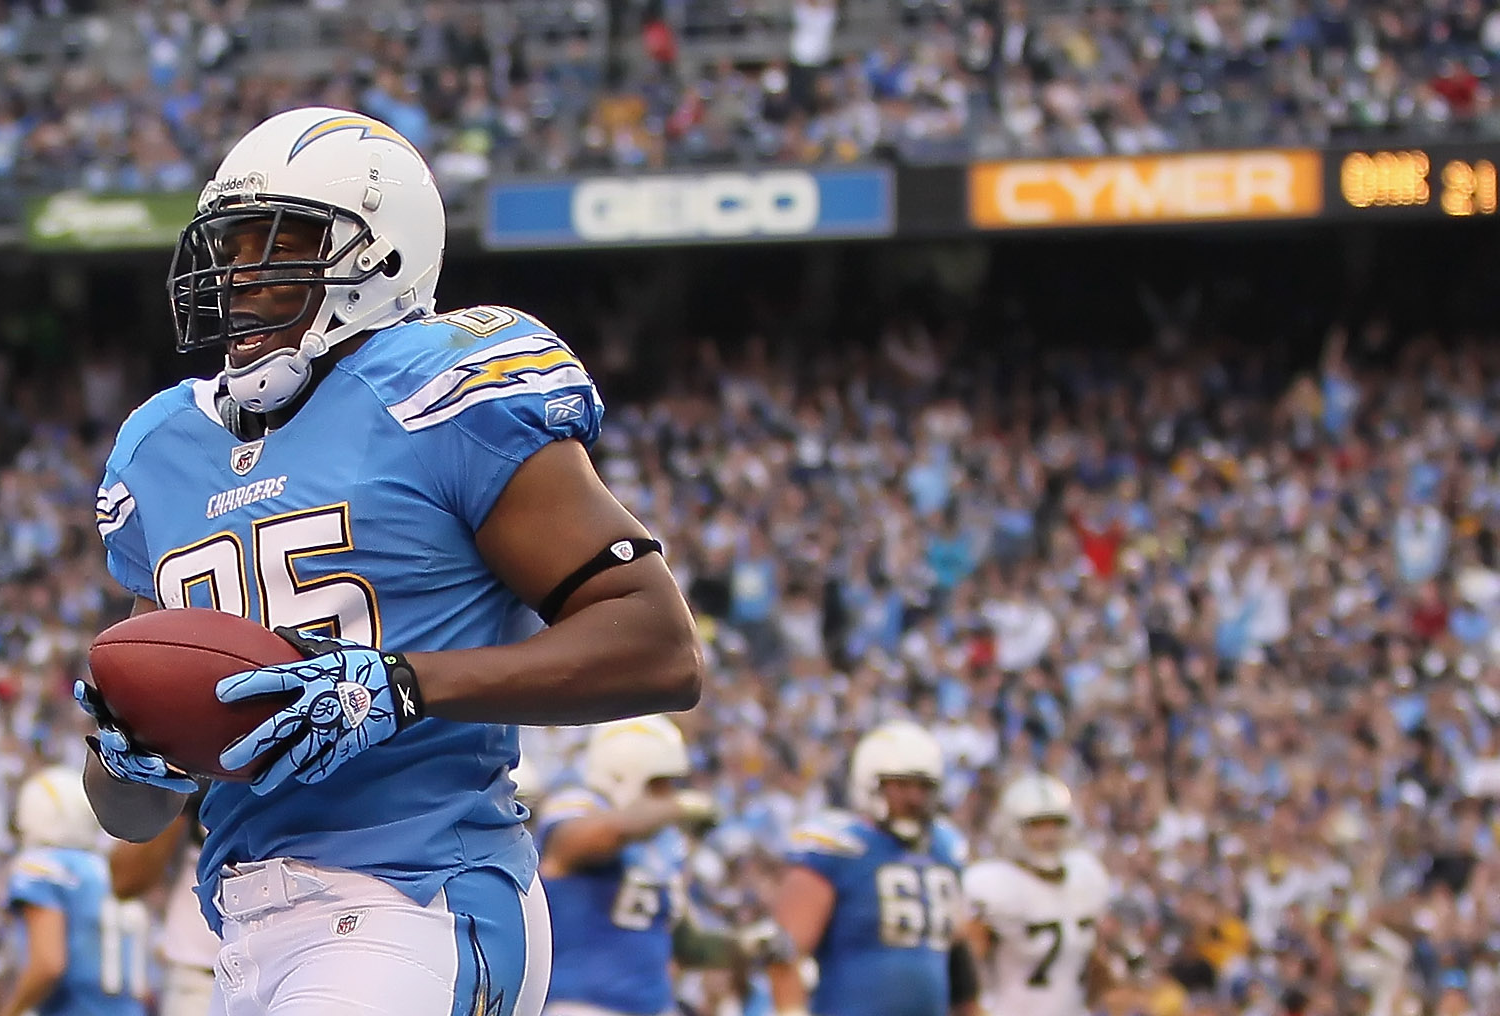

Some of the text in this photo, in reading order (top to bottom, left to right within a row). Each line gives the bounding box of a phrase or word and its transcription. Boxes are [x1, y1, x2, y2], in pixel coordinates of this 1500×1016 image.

[369, 168, 380, 181] 85
[998, 153, 1295, 223] CYMER
[572, 171, 819, 243] GEICO
[206, 475, 288, 519] CHARGERS
